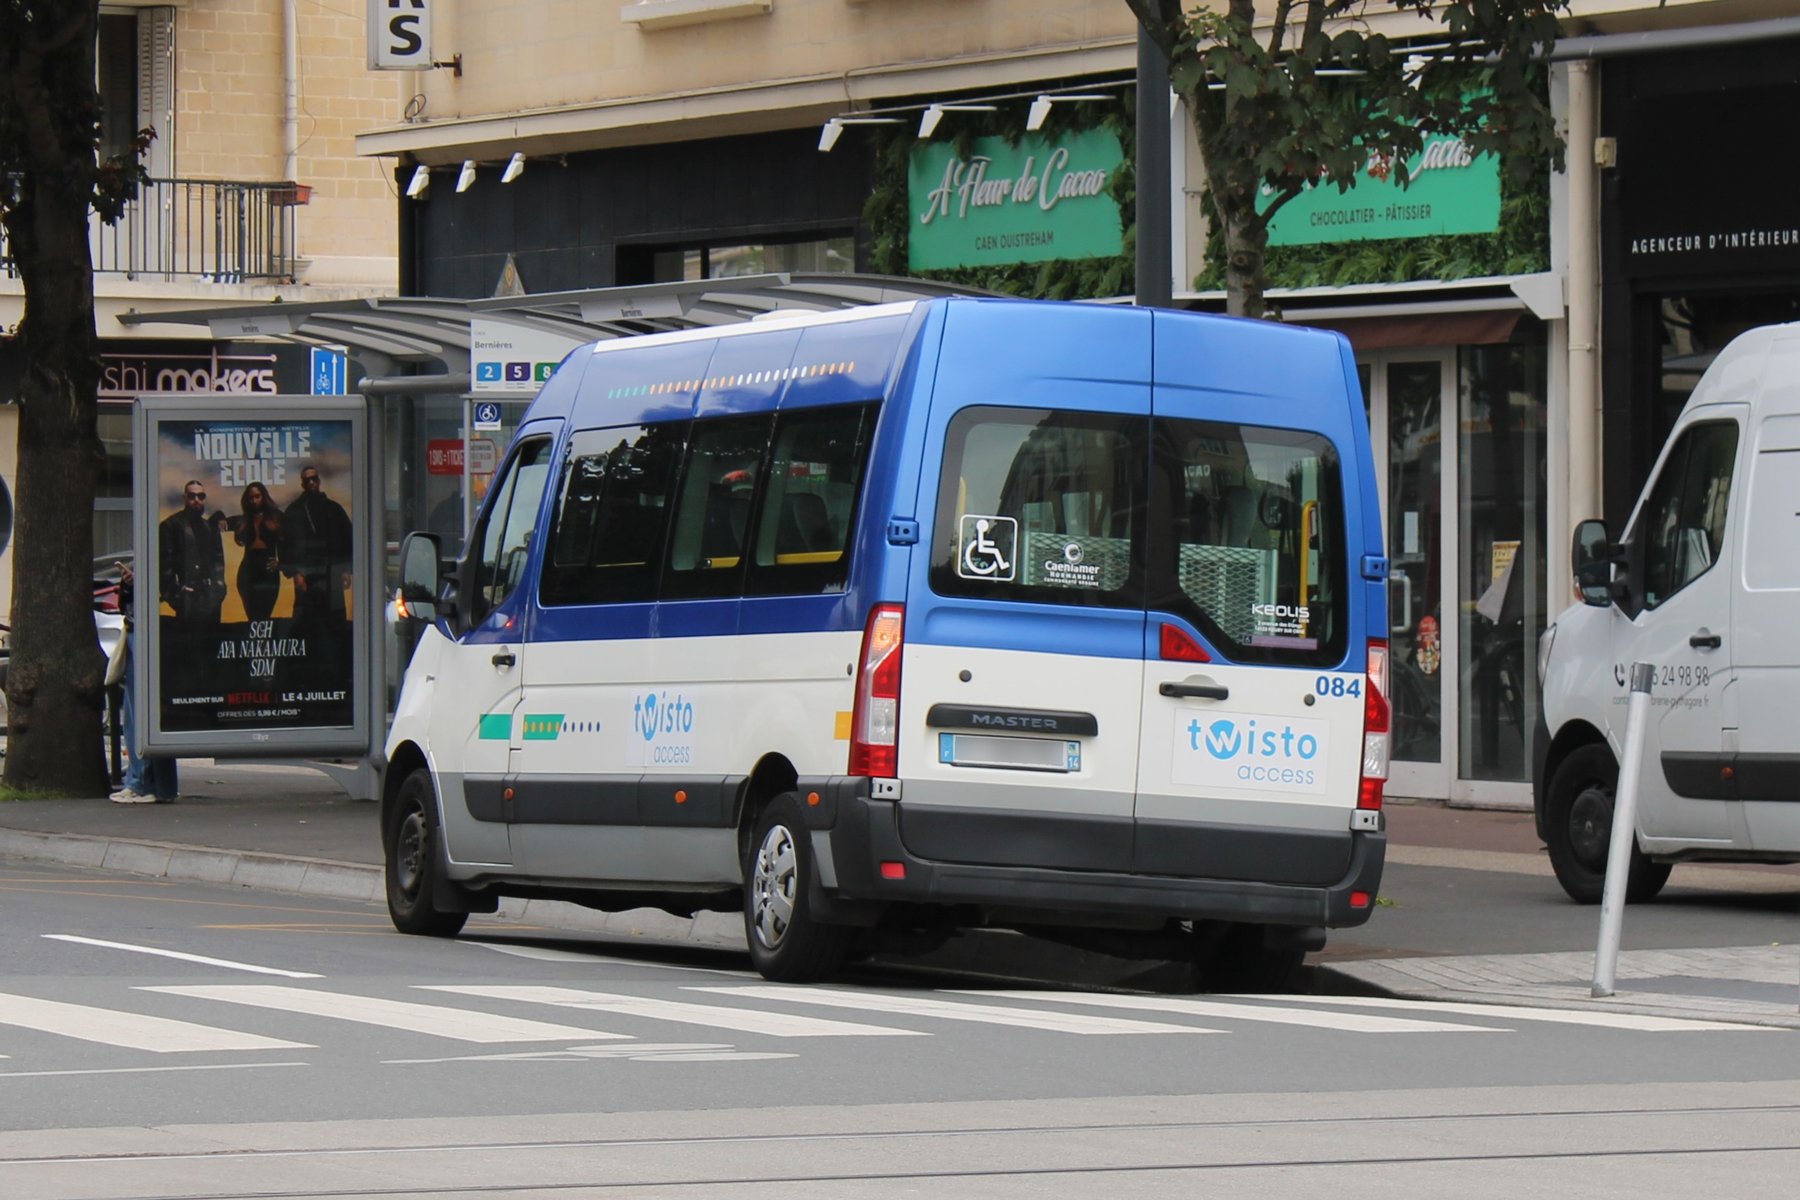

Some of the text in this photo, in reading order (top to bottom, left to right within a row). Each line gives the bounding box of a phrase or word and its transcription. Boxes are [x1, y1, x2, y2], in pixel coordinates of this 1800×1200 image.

[1011, 156, 1038, 202] de
[1039, 148, 1107, 210] Cacao
[1310, 207, 1375, 227] CHOCOLATIER
[1385, 203, 1432, 222] PÂTISSIER
[975, 231, 1055, 250] CAEN OUISTREHAM
[1631, 229, 1799, 254] AGENCEUR D'INTÉRIEUR
[474, 341, 513, 349] Bernières
[97, 346, 278, 394] shi makers
[484, 365, 551, 379] 2 5 8
[195, 431, 311, 460] NOUVELLE
[220, 459, 285, 487] ECOLE
[217, 638, 306, 659] AYA NAKAMURA
[249, 658, 276, 677] SDM
[1661, 665, 1675, 686] 24
[1678, 665, 1692, 686] 98
[1695, 665, 1710, 687] 98
[1315, 675, 1361, 698] 084
[172, 696, 211, 705] SEULEMENT
[227, 692, 271, 705] NETFLIX
[282, 692, 295, 702] LE
[297, 692, 303, 700] 4
[306, 691, 346, 701] JUILLET
[634, 691, 693, 741] twisto
[972, 713, 1058, 729] MASTER
[1187, 718, 1317, 760] twisto
[653, 746, 690, 763] access
[1068, 756, 1079, 769] 14
[1237, 764, 1315, 784] access
